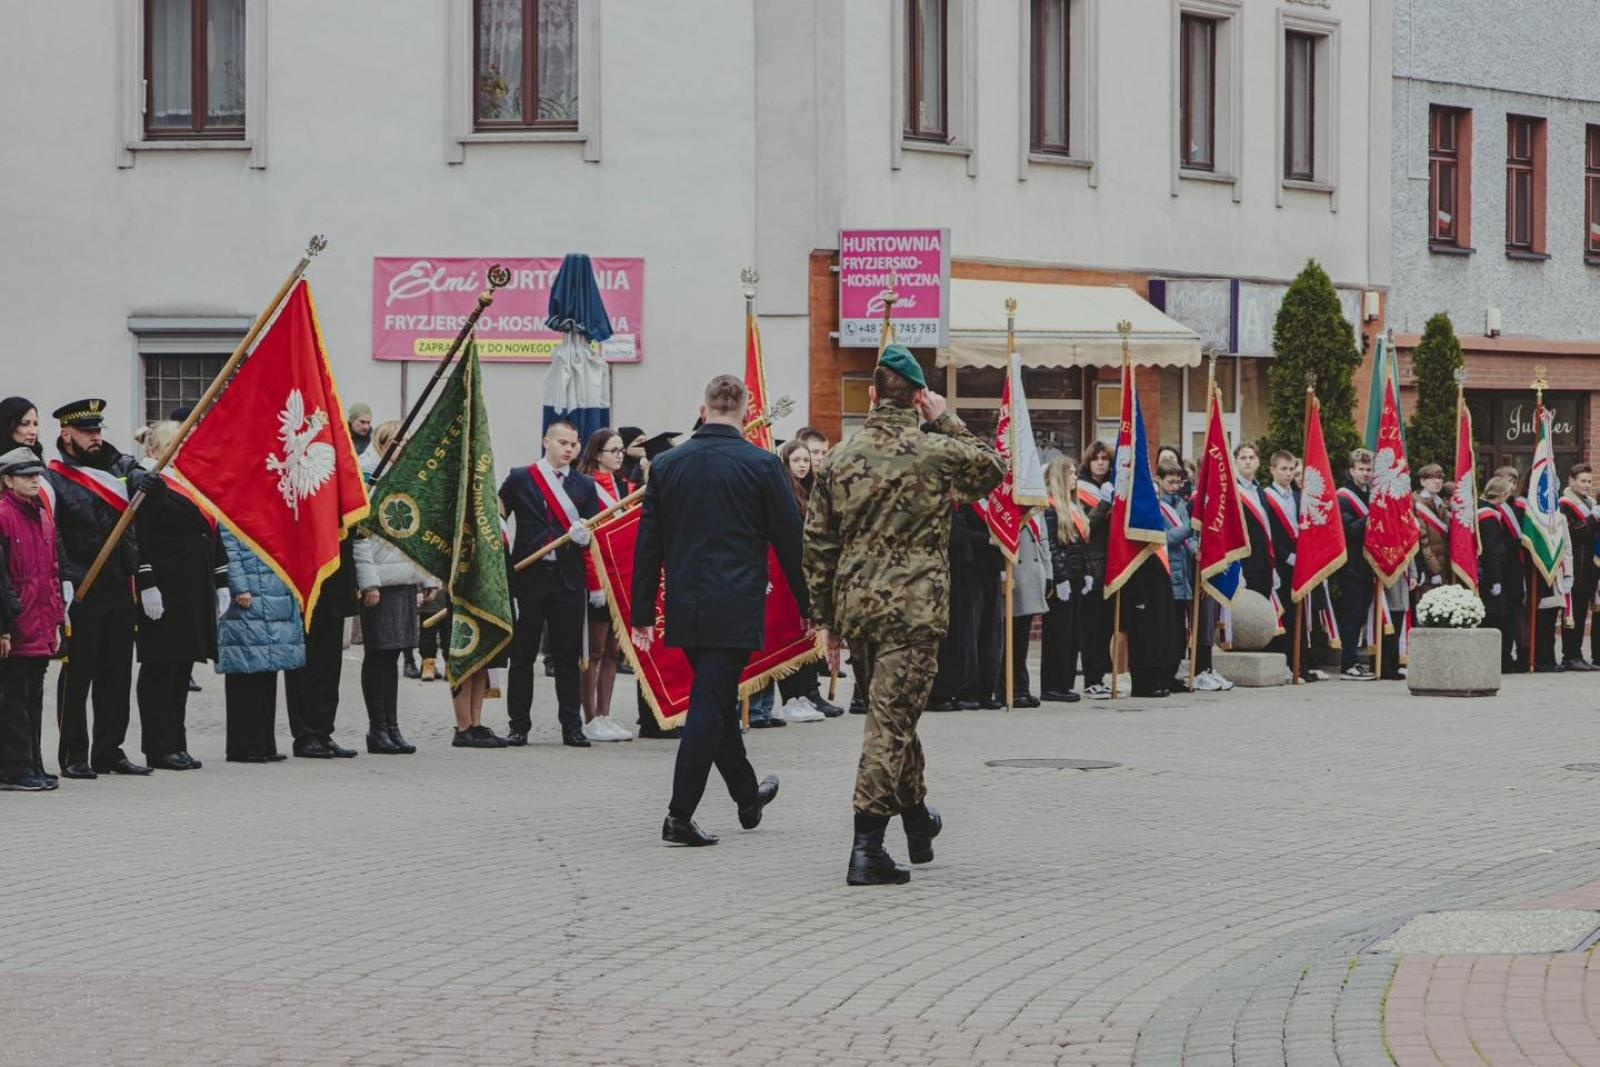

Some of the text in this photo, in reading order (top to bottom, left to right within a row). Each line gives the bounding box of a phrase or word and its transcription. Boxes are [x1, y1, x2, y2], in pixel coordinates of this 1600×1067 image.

[843, 236, 940, 251] HURTOWNIA
[386, 261, 479, 307] Elmi
[900, 323, 916, 333] 745
[919, 323, 937, 333] 783
[487, 342, 503, 353] DO
[504, 342, 552, 353] NOWEGO
